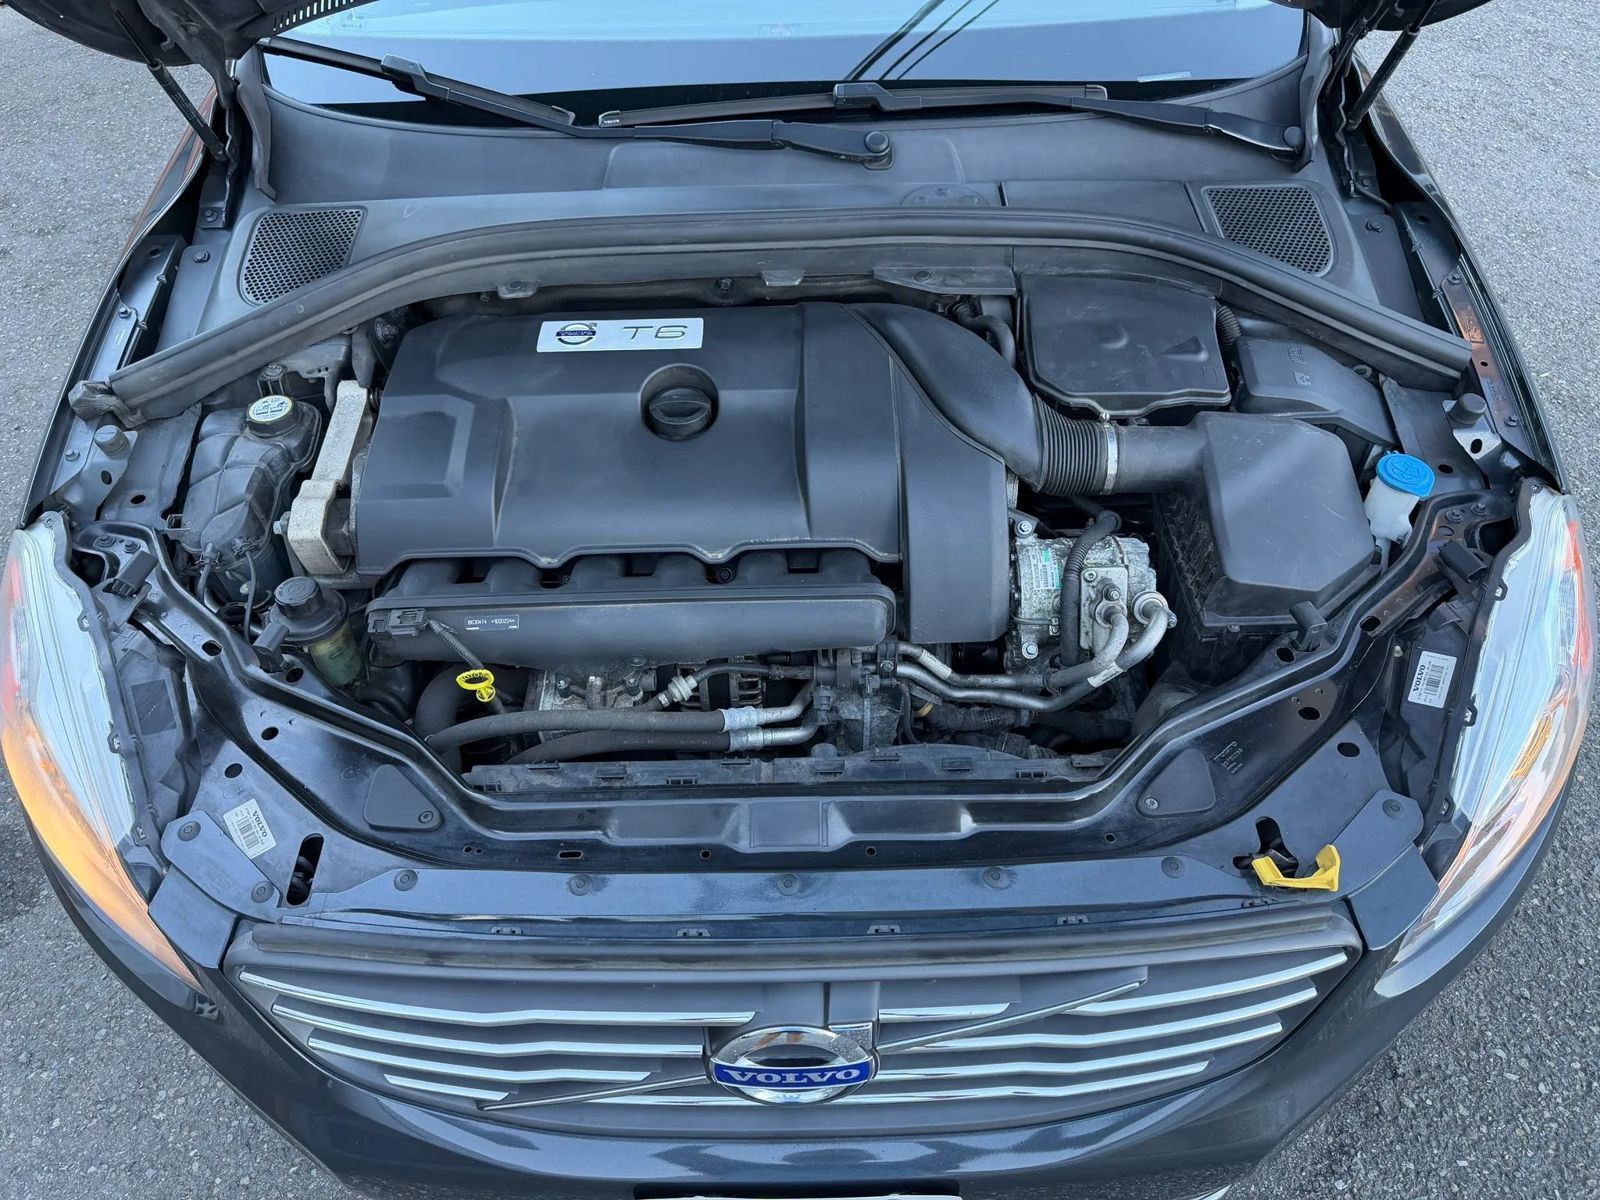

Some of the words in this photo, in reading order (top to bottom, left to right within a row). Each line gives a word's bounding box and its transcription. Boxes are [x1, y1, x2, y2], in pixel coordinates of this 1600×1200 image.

[623, 325, 688, 340] T6
[1412, 664, 1426, 692] VOLVO
[252, 810, 268, 838] VOLVO
[723, 1068, 861, 1084] VOLVO
